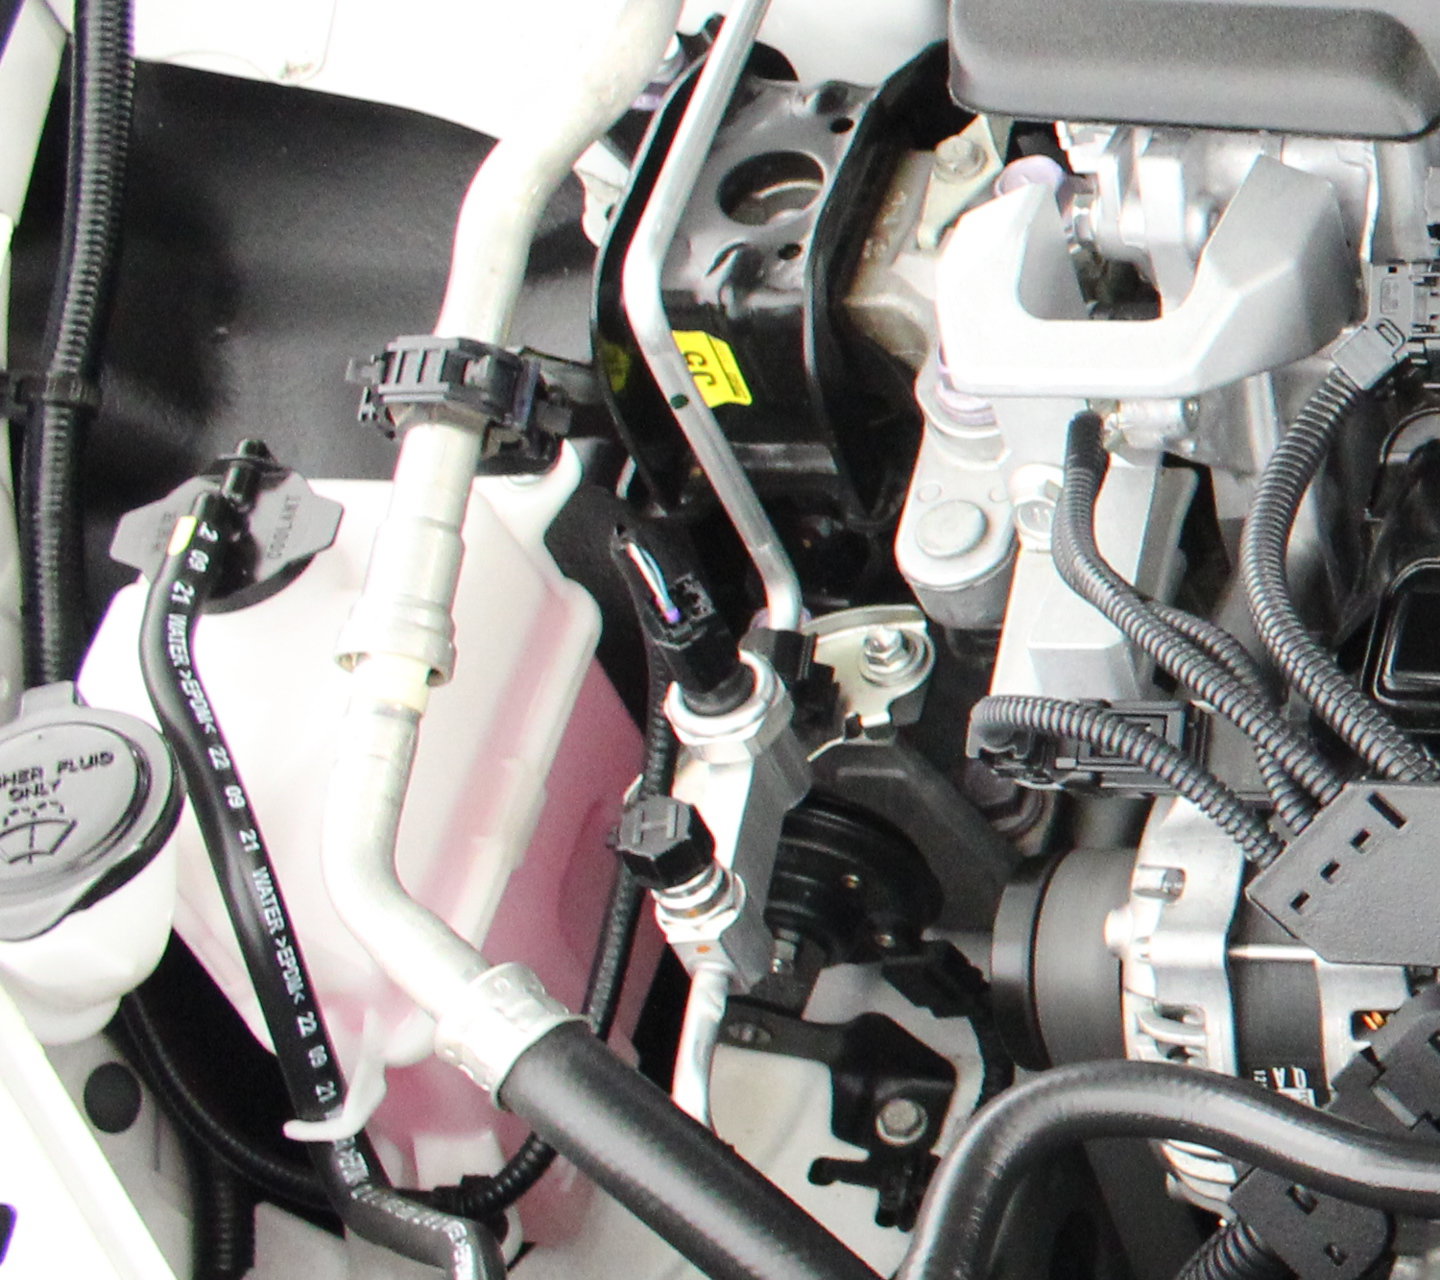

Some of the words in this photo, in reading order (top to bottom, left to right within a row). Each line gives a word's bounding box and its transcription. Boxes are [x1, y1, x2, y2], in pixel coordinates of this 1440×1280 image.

[171, 580, 196, 605] 21
[167, 614, 187, 667] WATER
[0, 766, 44, 789] HER
[57, 750, 115, 774] FLUID
[207, 742, 231, 772] 22
[8, 778, 61, 802] ONLY
[222, 781, 247, 811] 09
[238, 825, 261, 853] 21
[251, 868, 287, 936] WATER
[295, 1010, 319, 1037] 22
[306, 1044, 329, 1068] 09
[313, 1079, 337, 1104] 21
